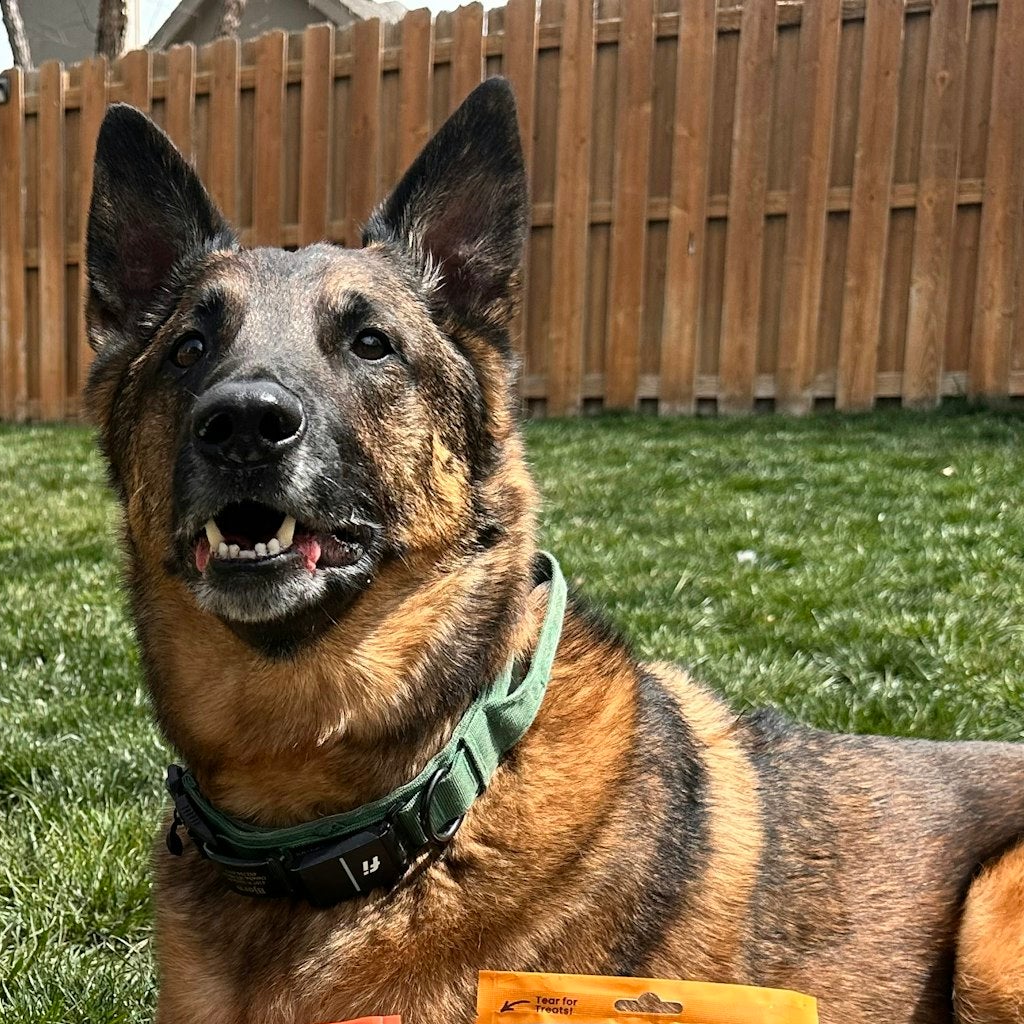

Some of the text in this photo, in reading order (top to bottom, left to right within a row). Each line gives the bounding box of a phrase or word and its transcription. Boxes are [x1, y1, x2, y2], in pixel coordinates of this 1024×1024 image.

[536, 996, 578, 1006] Tear for
[535, 1005, 573, 1015] Treats!
